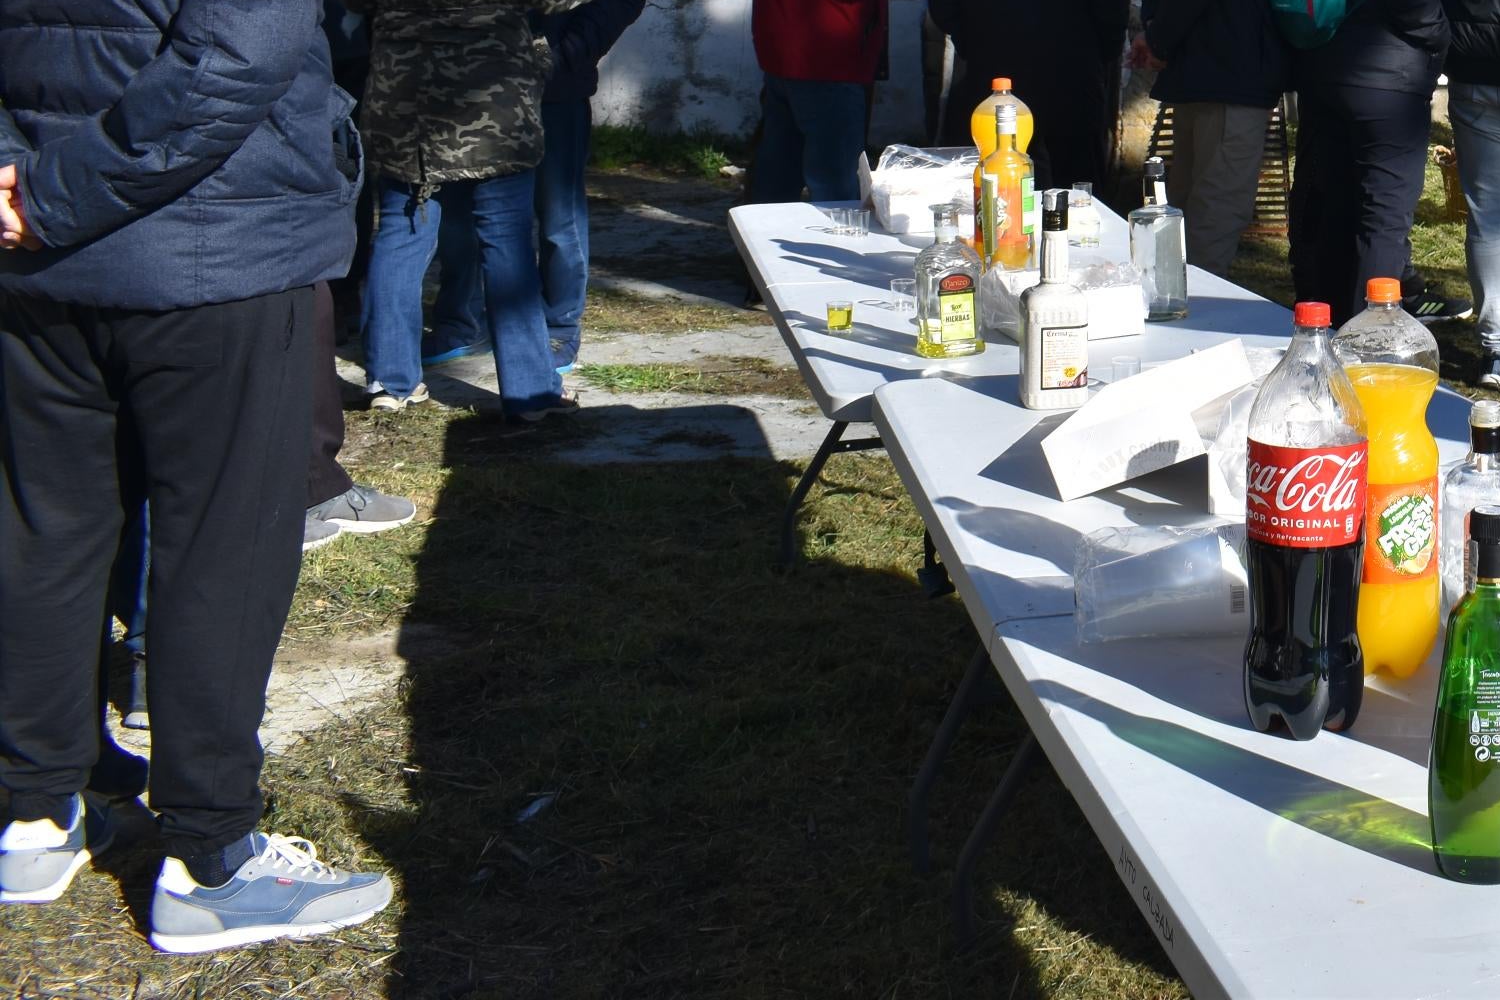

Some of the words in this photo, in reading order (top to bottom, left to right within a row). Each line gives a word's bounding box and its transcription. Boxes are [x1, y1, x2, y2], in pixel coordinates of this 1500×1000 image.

[945, 314, 970, 323] HIERBAS
[1246, 449, 1366, 513] ca-Cola
[1248, 509, 1266, 524] BOR
[1270, 516, 1341, 529] ORIGINAL
[1377, 493, 1434, 557] FRESH
[1276, 533, 1324, 542] Refrescante
[1402, 514, 1433, 557] GAS
